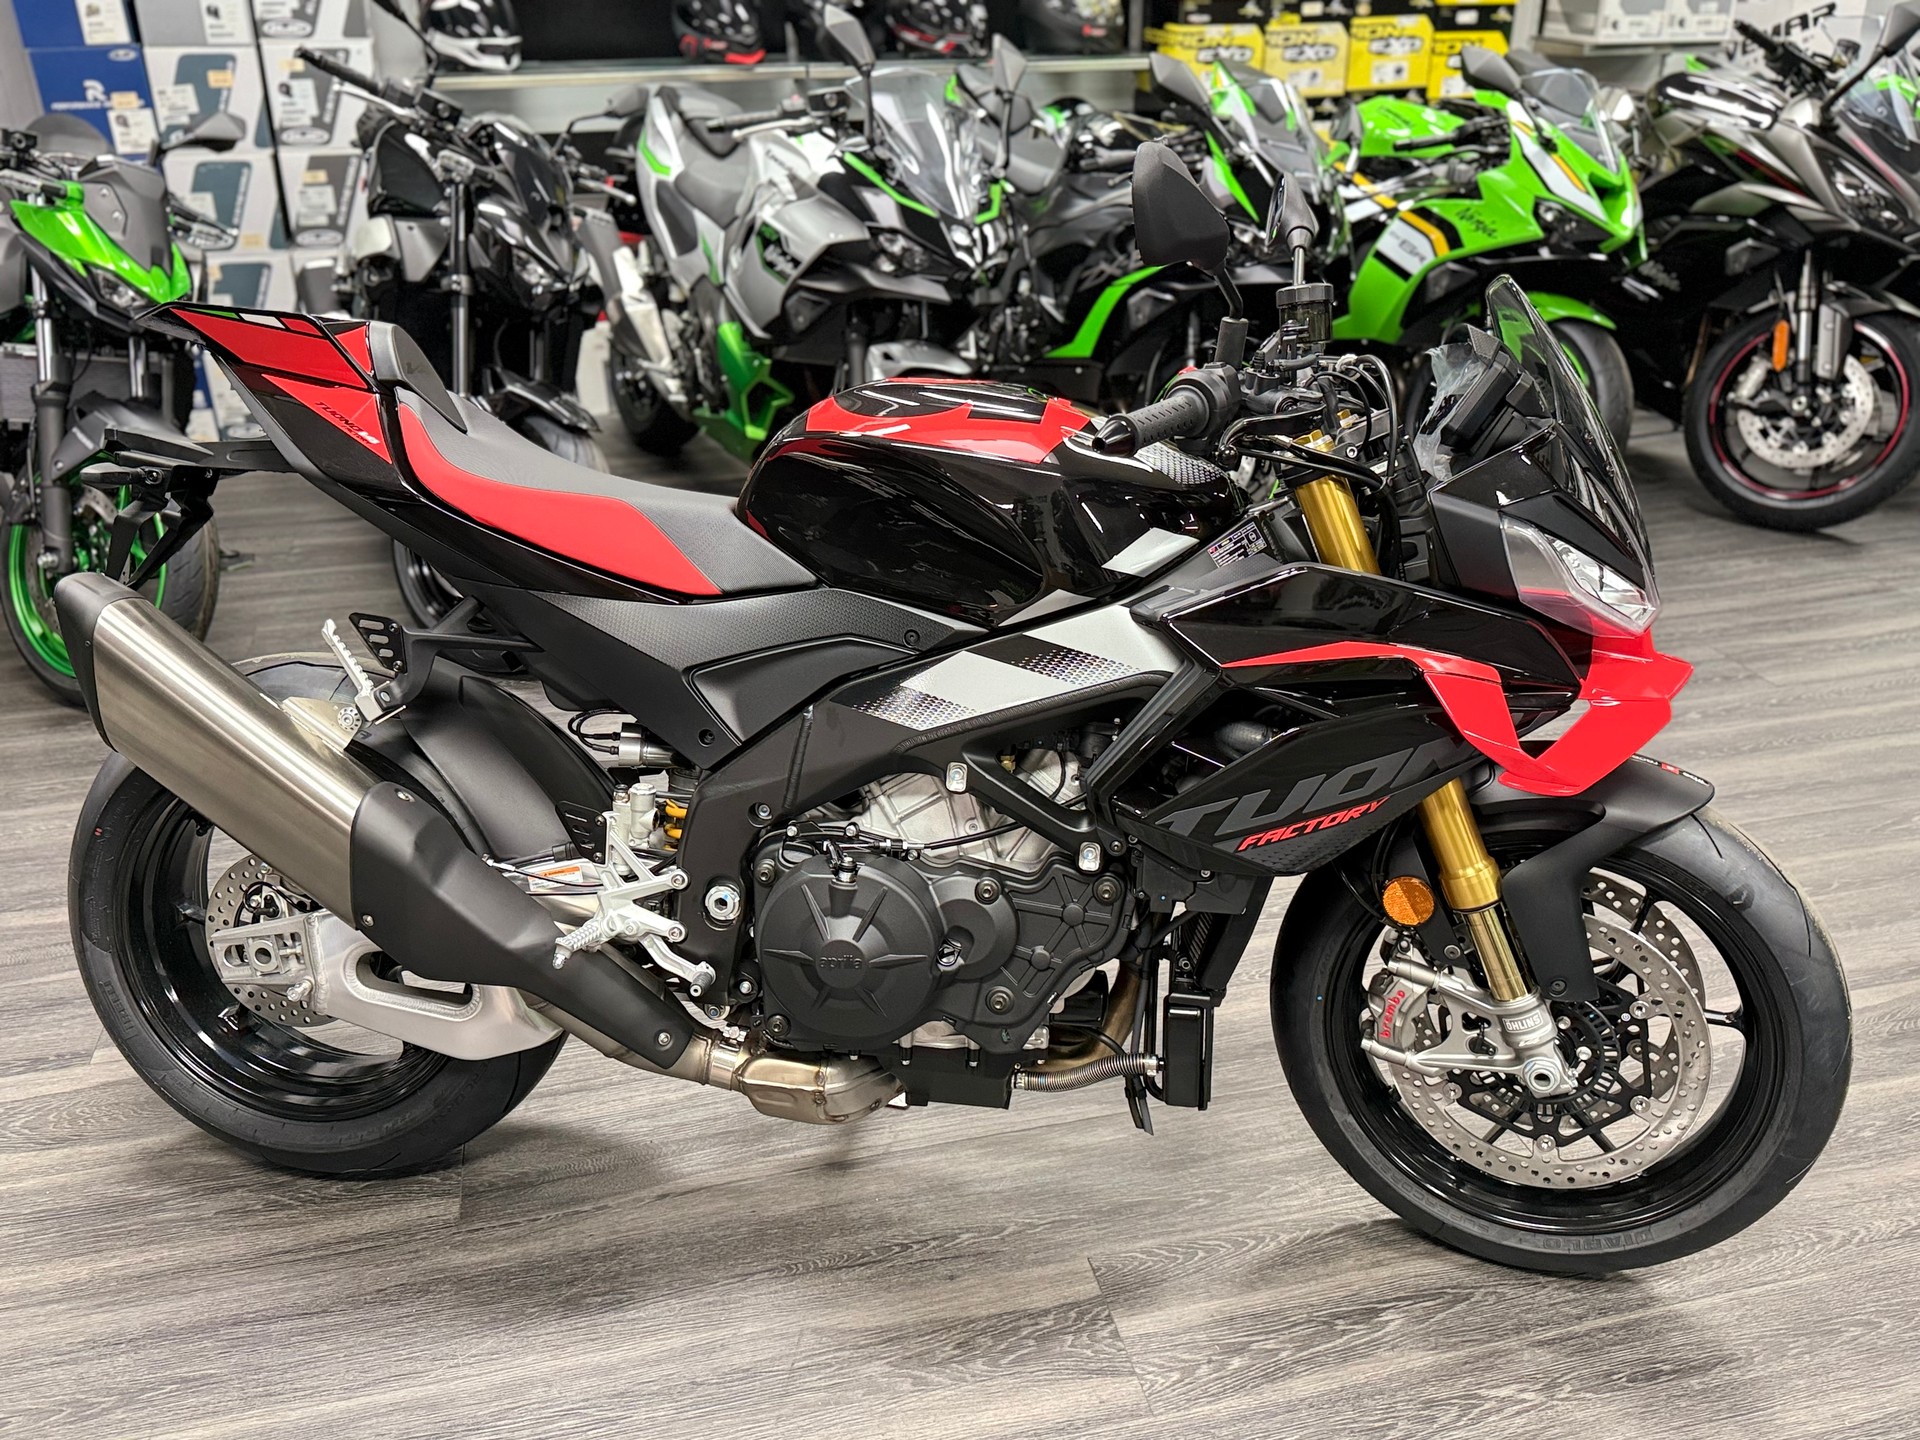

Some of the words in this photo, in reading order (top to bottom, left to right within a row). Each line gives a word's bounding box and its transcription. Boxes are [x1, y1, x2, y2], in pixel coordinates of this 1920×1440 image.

[1725, 2, 1836, 61] VEAR
[315, 401, 364, 433] TUONO
[1156, 736, 1480, 837] TUON
[1235, 795, 1390, 853] FACTORY
[820, 954, 862, 970] aprilia
[1380, 990, 1406, 1039] brembo
[1369, 1151, 1490, 1234] SUPERCORSA
[1542, 1228, 1654, 1252] DIABLO
